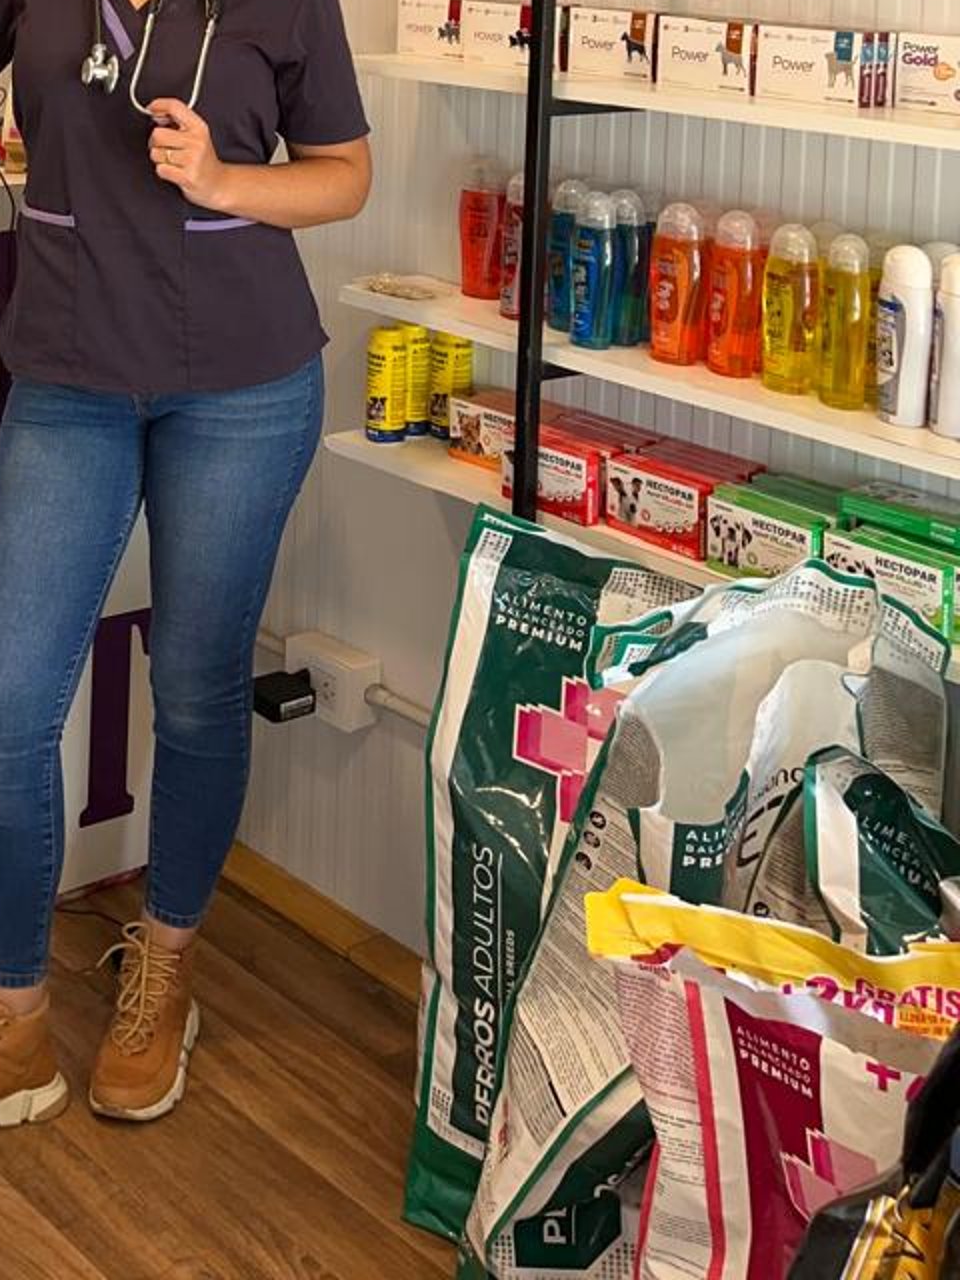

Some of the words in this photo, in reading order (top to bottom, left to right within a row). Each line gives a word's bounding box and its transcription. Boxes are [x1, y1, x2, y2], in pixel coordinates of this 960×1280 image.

[671, 45, 710, 62] Power
[772, 55, 815, 72] Power
[902, 52, 939, 67] Gold
[903, 41, 940, 54] Power
[501, 591, 588, 627] ALIMENTO
[495, 613, 583, 653] PREMIUM
[473, 843, 495, 999] ADULTOS
[736, 1026, 811, 1071] ALIMENTO
[740, 1049, 814, 1098] PREMIUM
